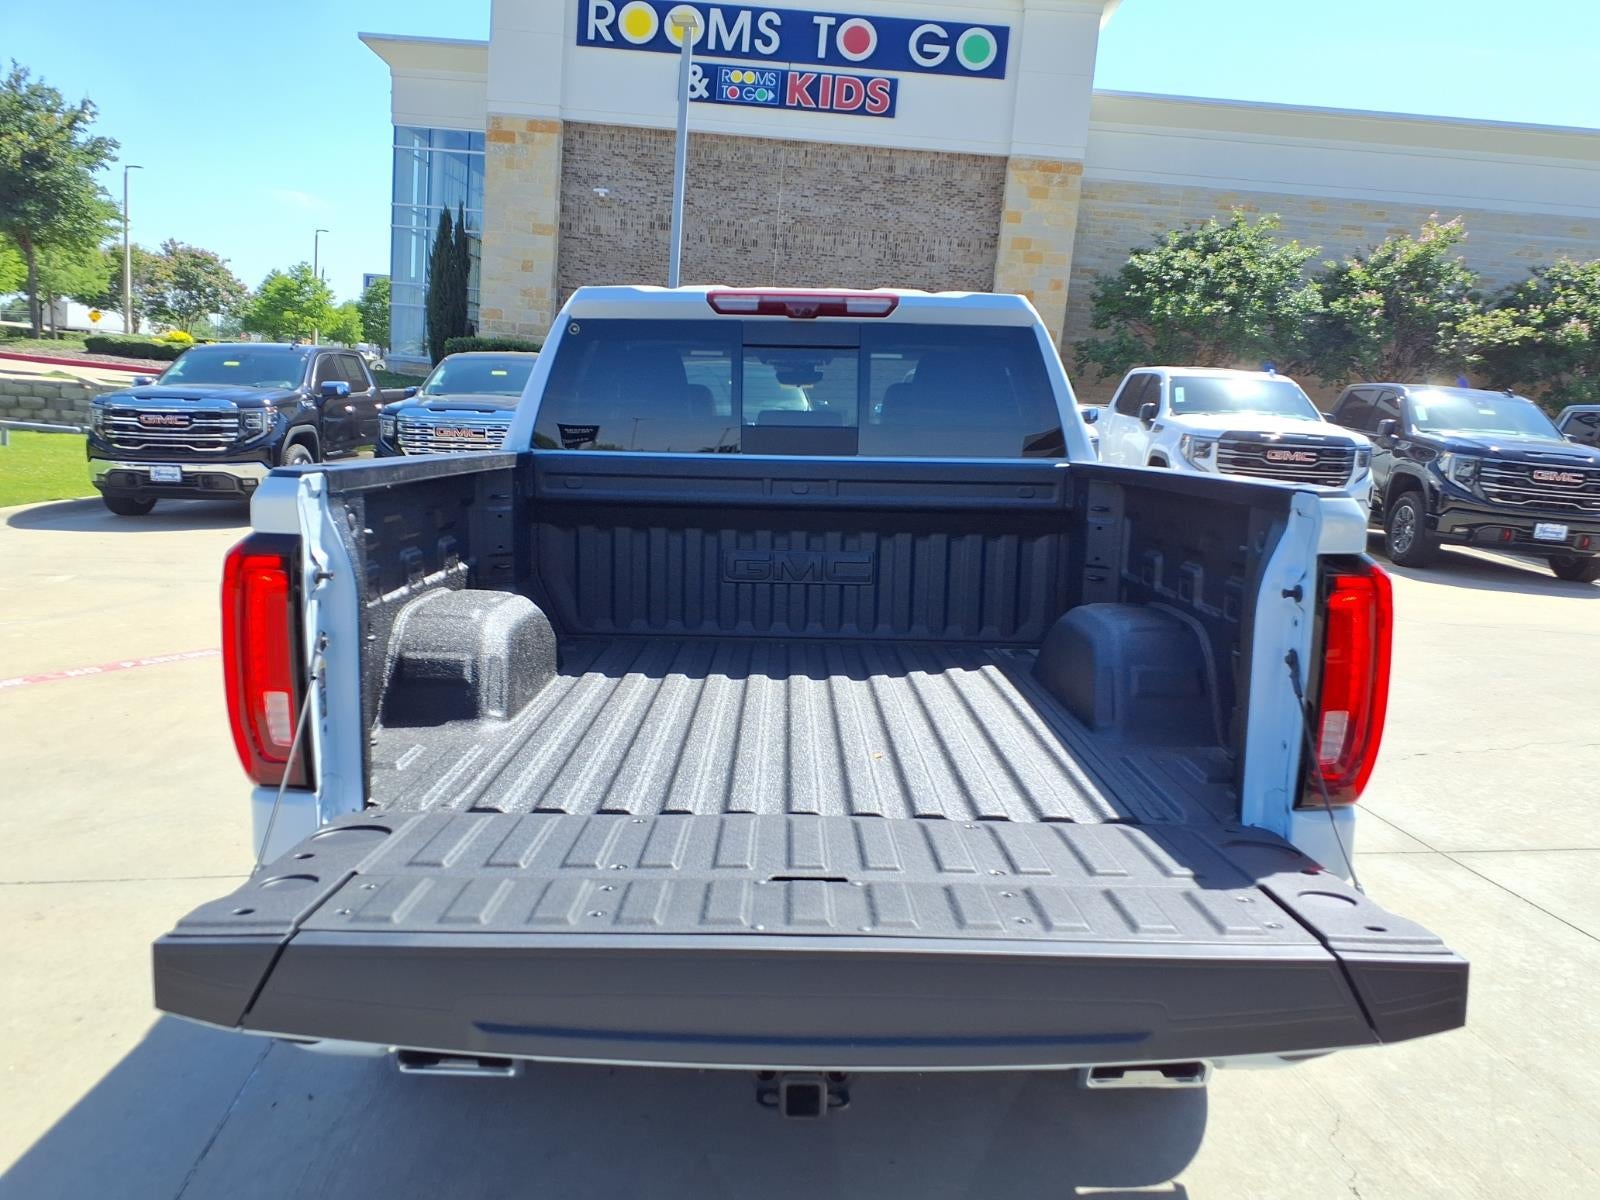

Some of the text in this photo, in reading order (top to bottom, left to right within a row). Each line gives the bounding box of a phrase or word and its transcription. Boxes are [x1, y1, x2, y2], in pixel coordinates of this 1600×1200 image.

[587, 0, 998, 71] ROOMS TO GO
[721, 69, 776, 86] ROOMS
[721, 85, 768, 102] TO GO
[785, 71, 891, 114] KIDS
[139, 414, 190, 426] GMC
[436, 427, 485, 438] GMC
[1266, 449, 1318, 462] GMC
[1533, 470, 1584, 483] GMC
[725, 551, 871, 582] GMC
